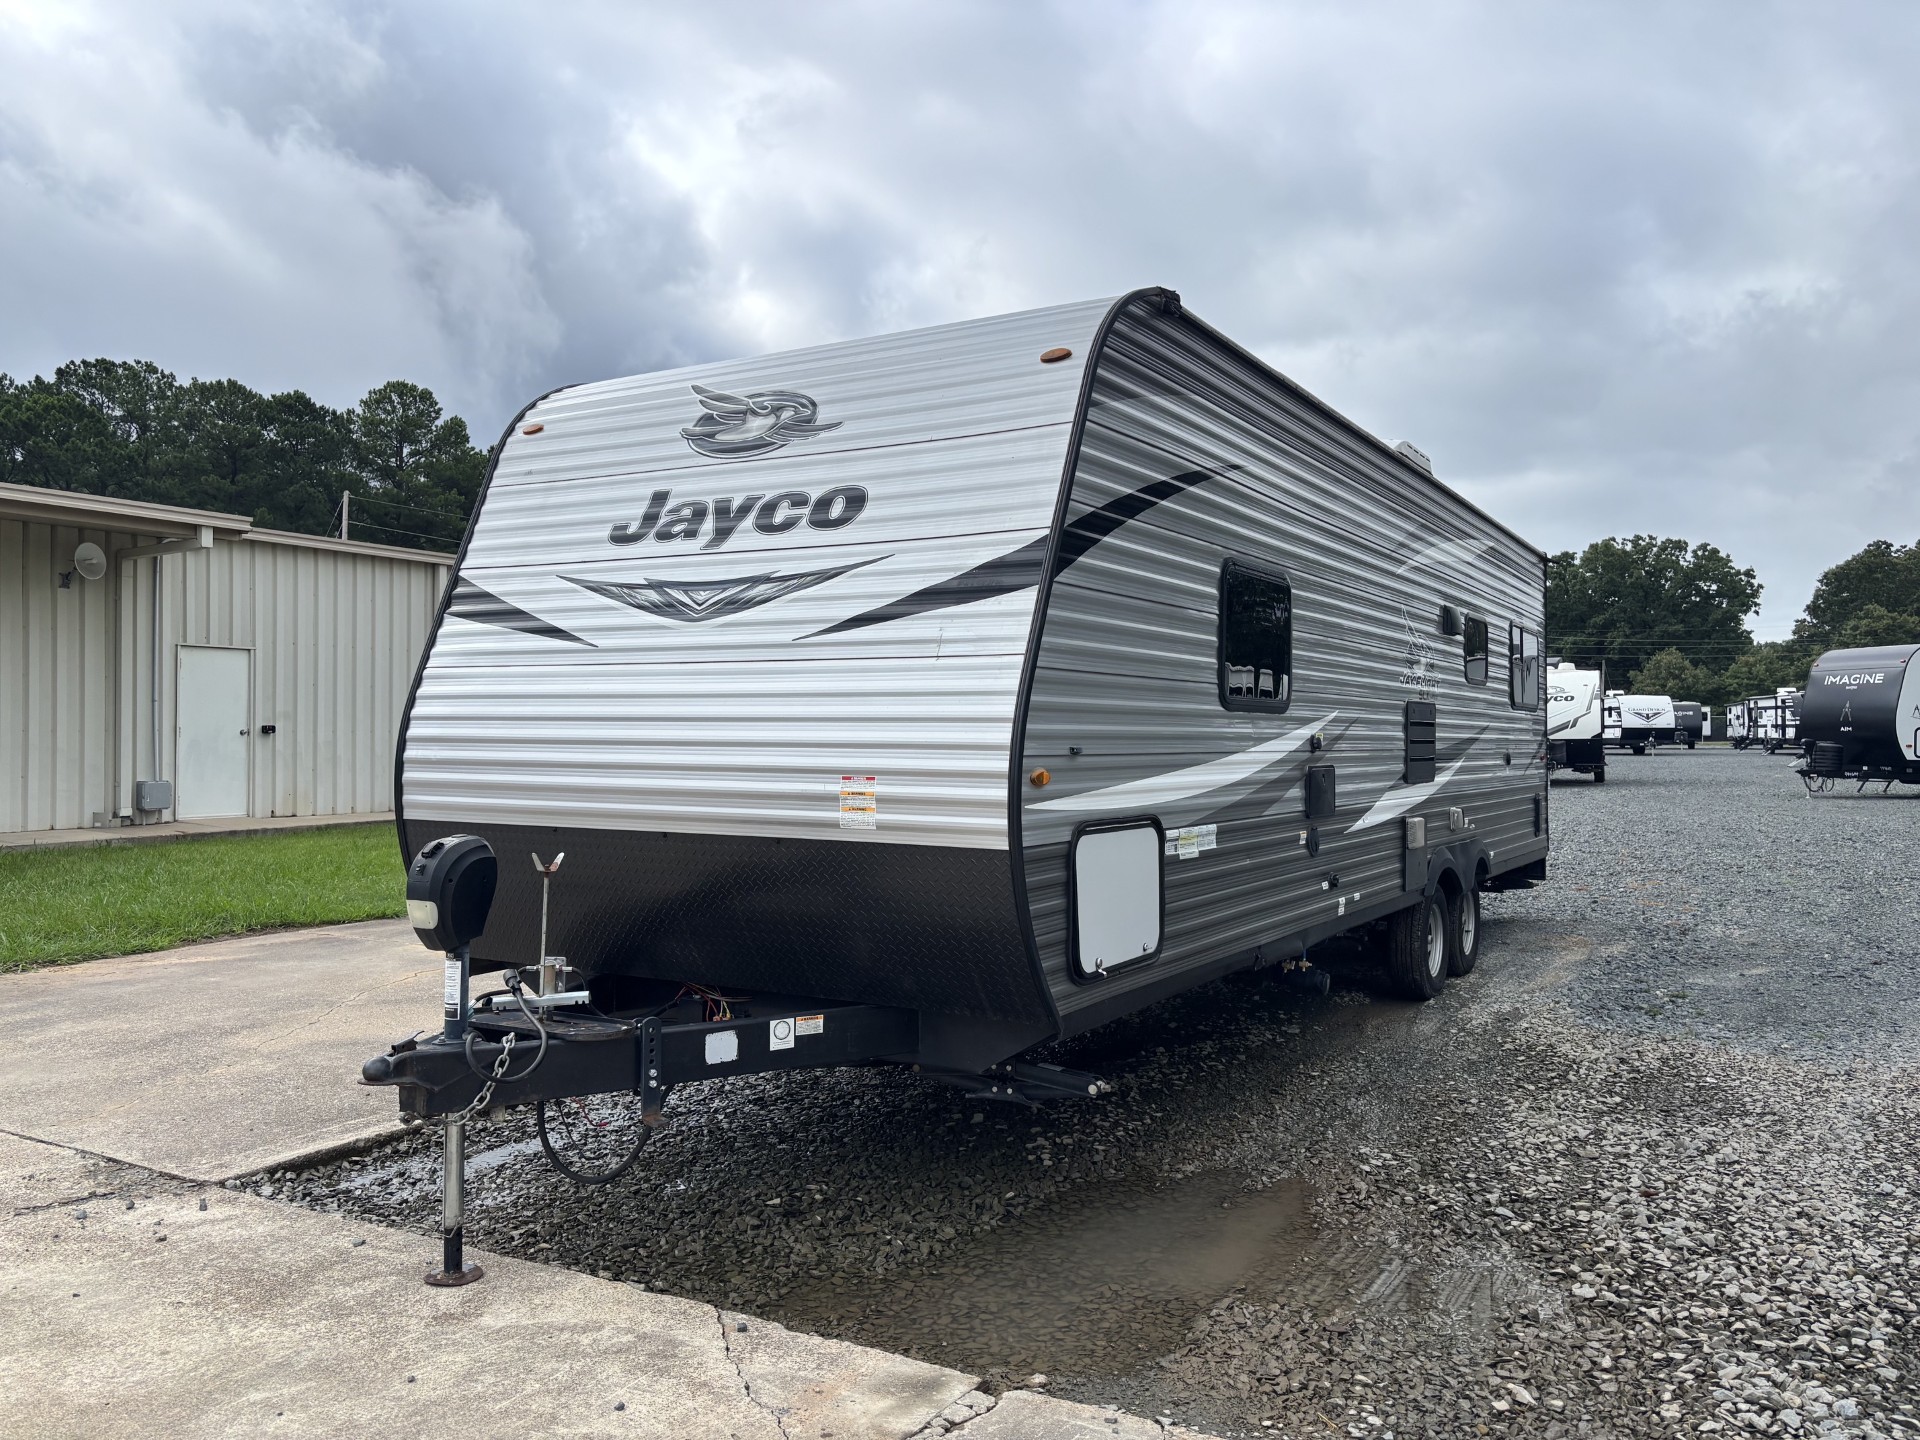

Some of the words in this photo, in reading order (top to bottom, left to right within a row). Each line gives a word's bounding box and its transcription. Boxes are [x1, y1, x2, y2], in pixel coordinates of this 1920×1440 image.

[607, 484, 869, 550] Jayco
[1824, 673, 1885, 685] IMAGINE
[1547, 695, 1575, 704] yco
